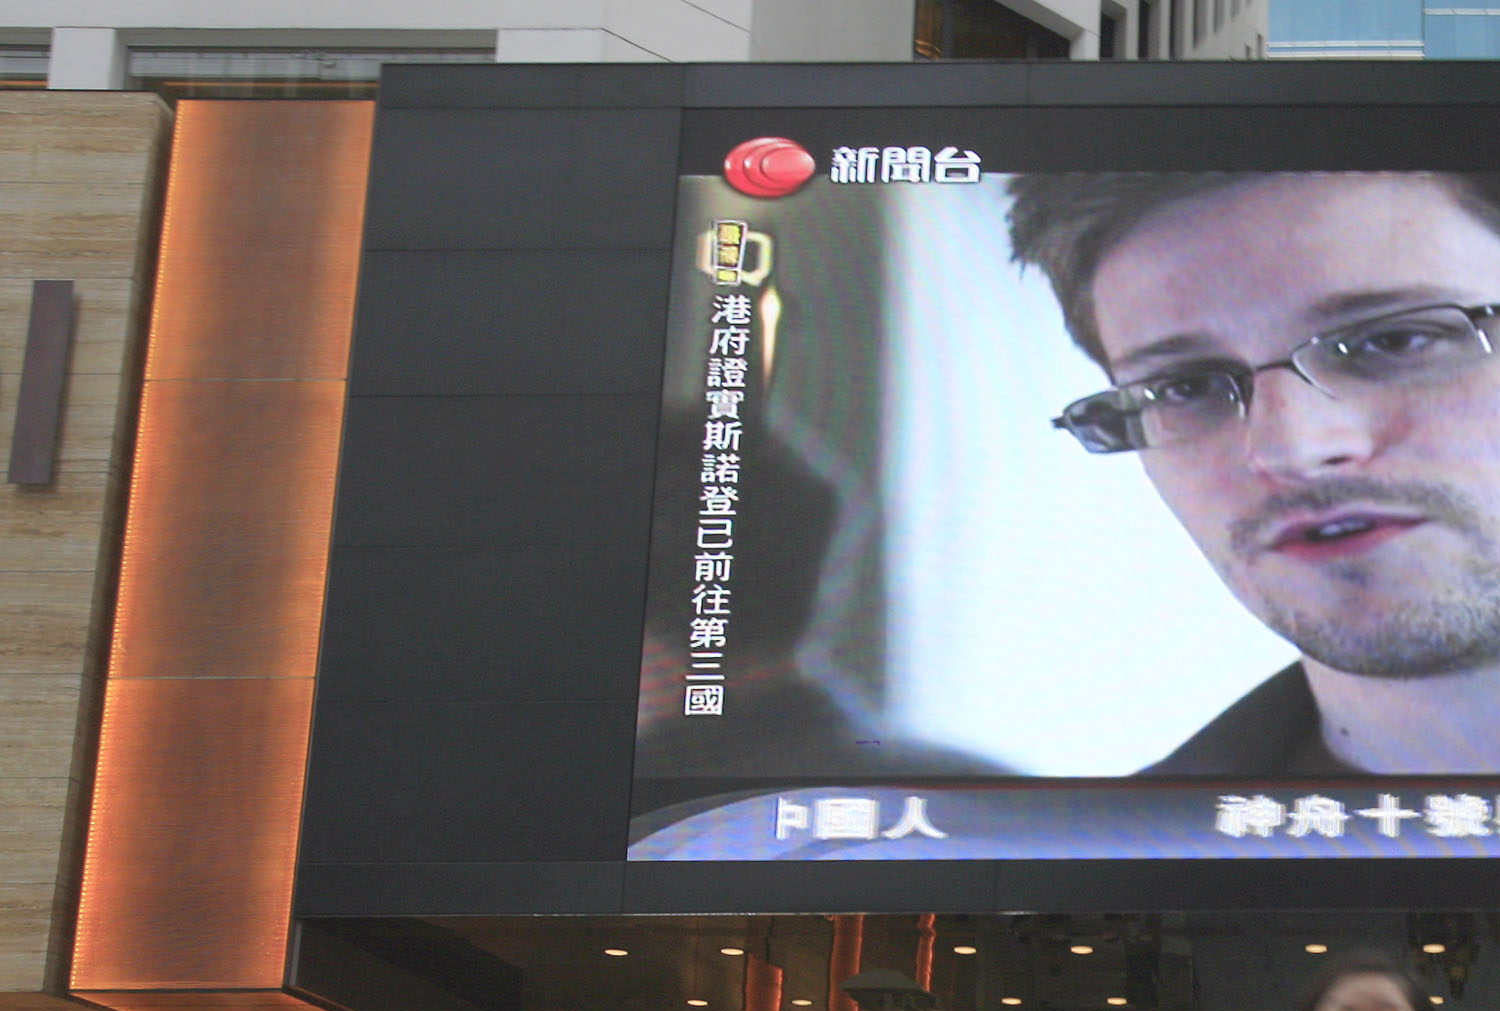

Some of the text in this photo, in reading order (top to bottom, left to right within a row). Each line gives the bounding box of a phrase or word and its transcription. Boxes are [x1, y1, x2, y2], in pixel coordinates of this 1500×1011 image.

[830, 146, 982, 184] 新聞台
[684, 294, 752, 716] 港府證實斯諾登已前往第三國
